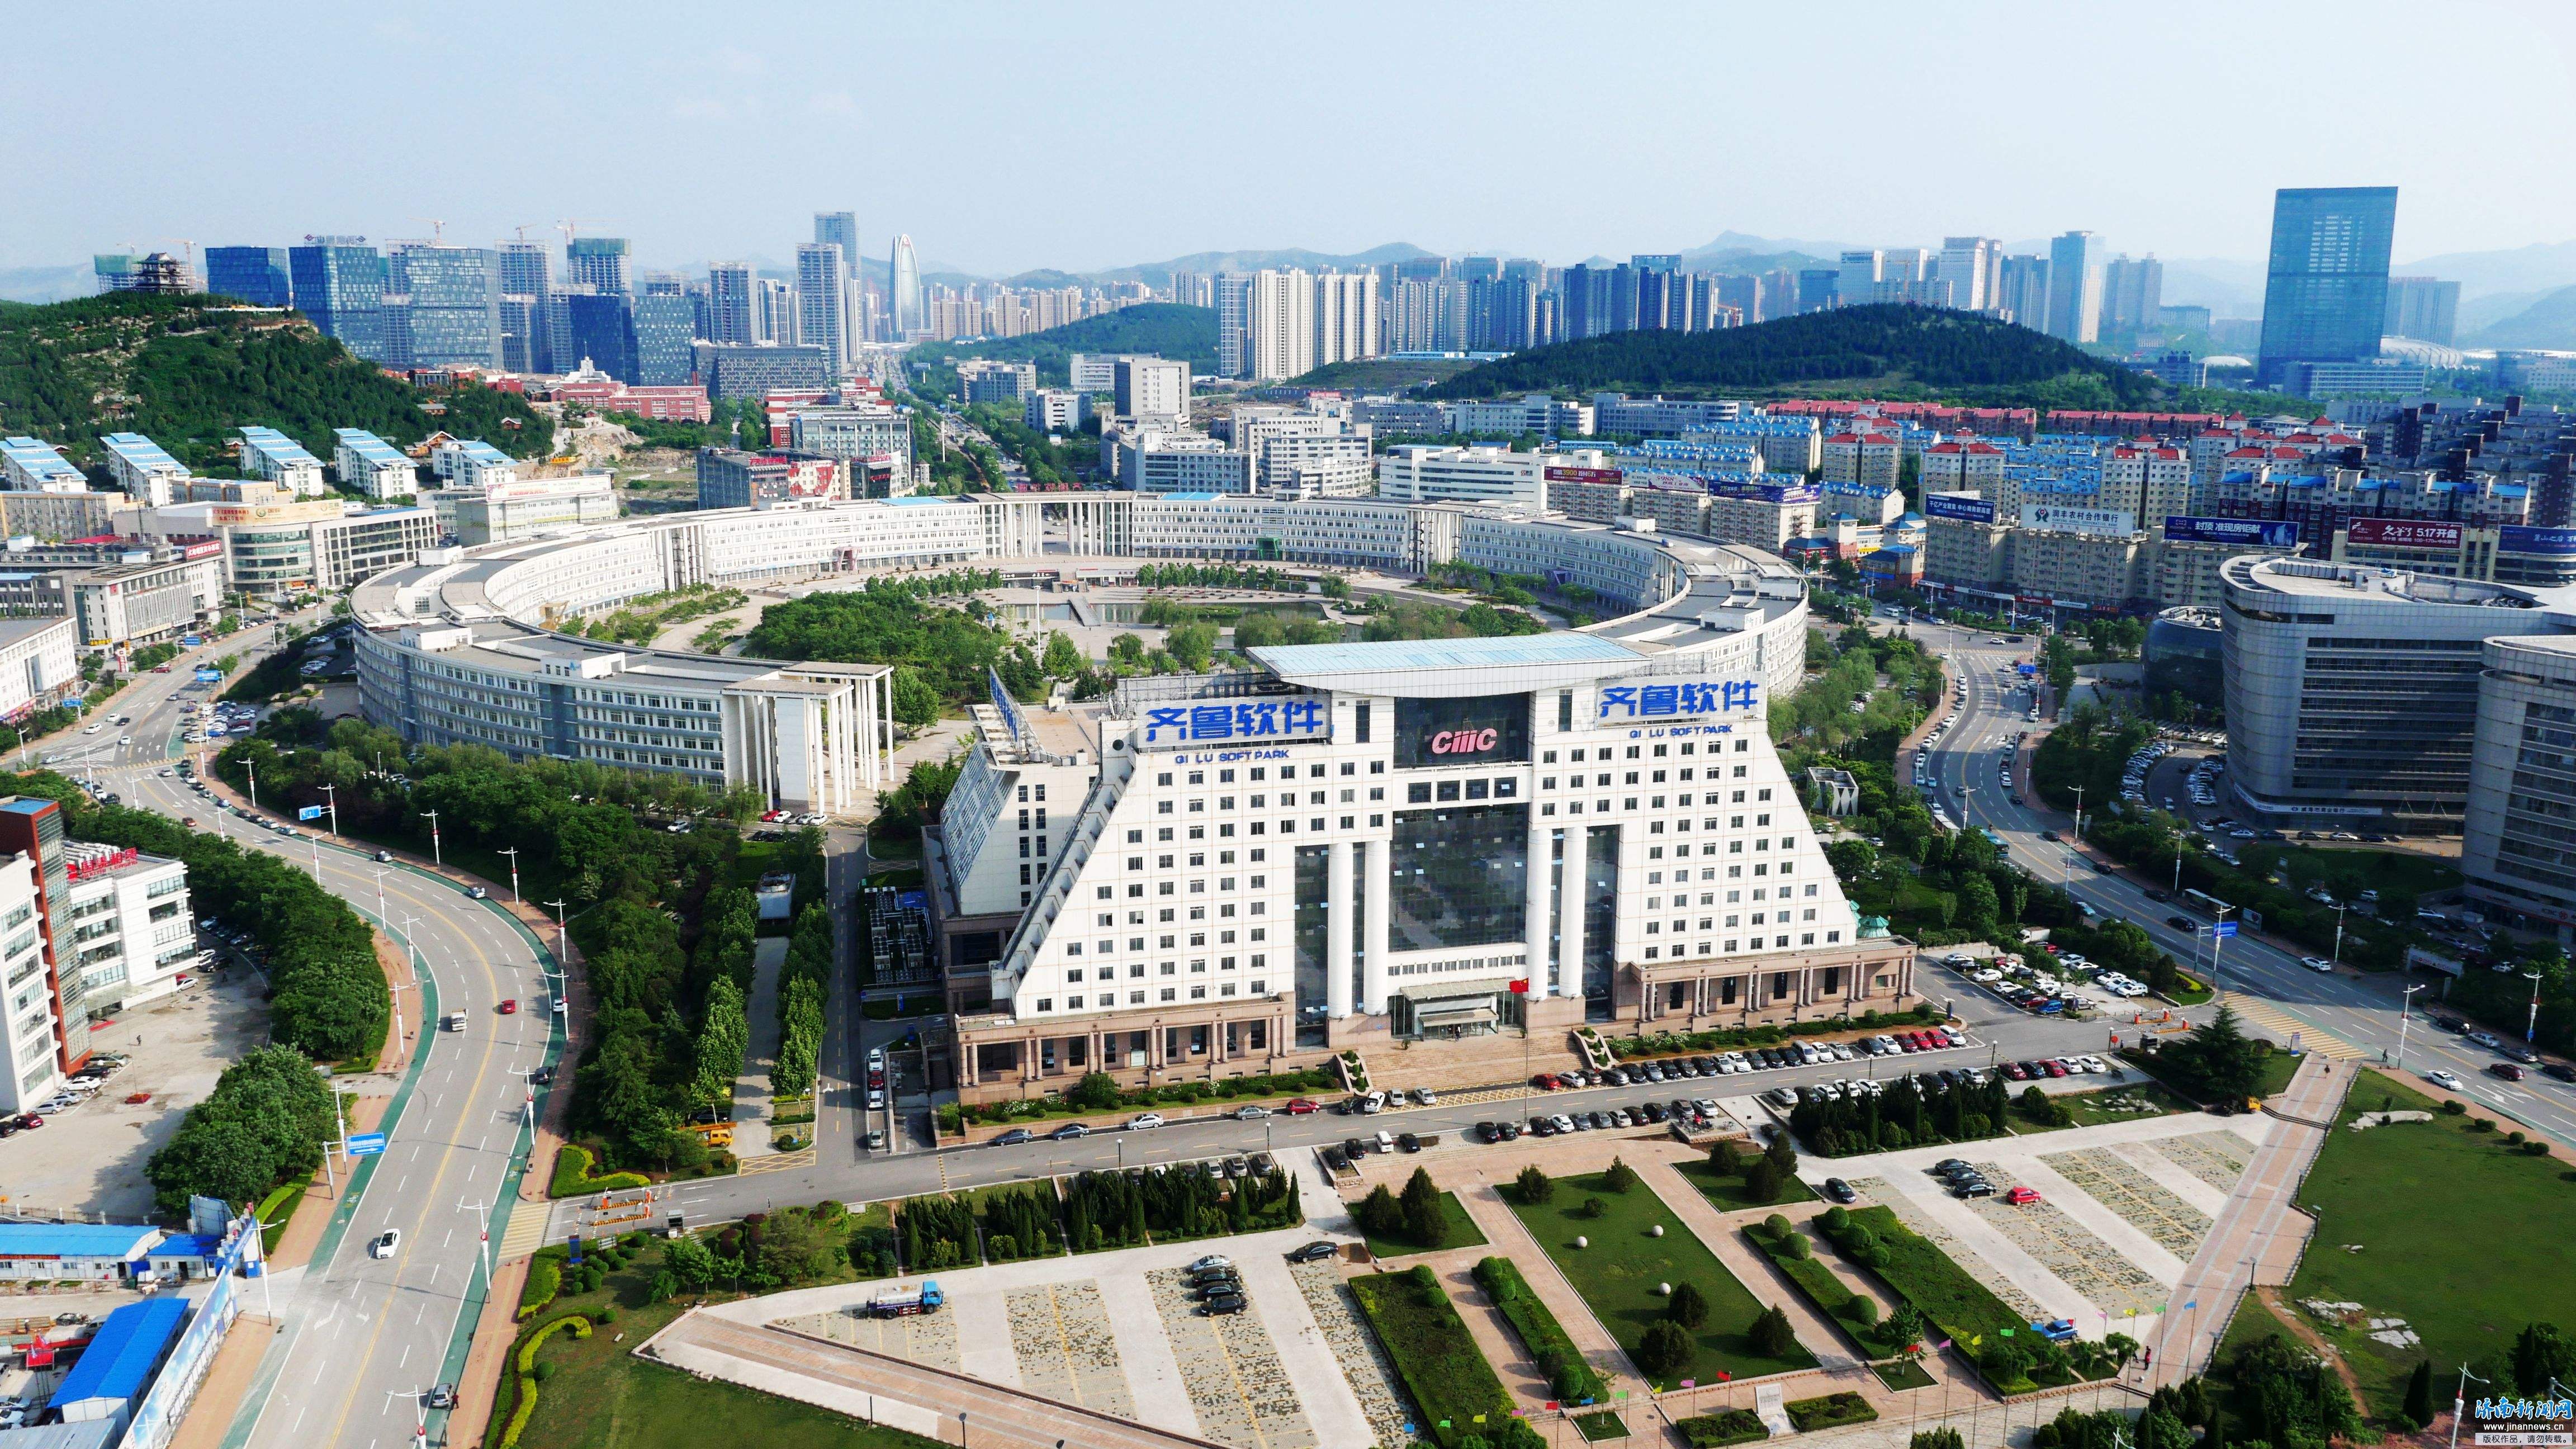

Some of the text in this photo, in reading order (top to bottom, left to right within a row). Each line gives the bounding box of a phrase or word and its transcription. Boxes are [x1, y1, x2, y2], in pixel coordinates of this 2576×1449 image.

[2052, 509, 2119, 523] 润丰农村合作银行
[2195, 522, 2214, 531] 封顶
[2416, 528, 2457, 538] 5.17开盘
[1600, 680, 1760, 717] 齐鲁软件
[1147, 700, 1323, 742] 齐鲁软件
[1630, 730, 1641, 738] QI
[1649, 728, 1664, 737] LU
[1703, 724, 1733, 734] PARK
[1175, 750, 1290, 764] QI LU SOFT PARK
